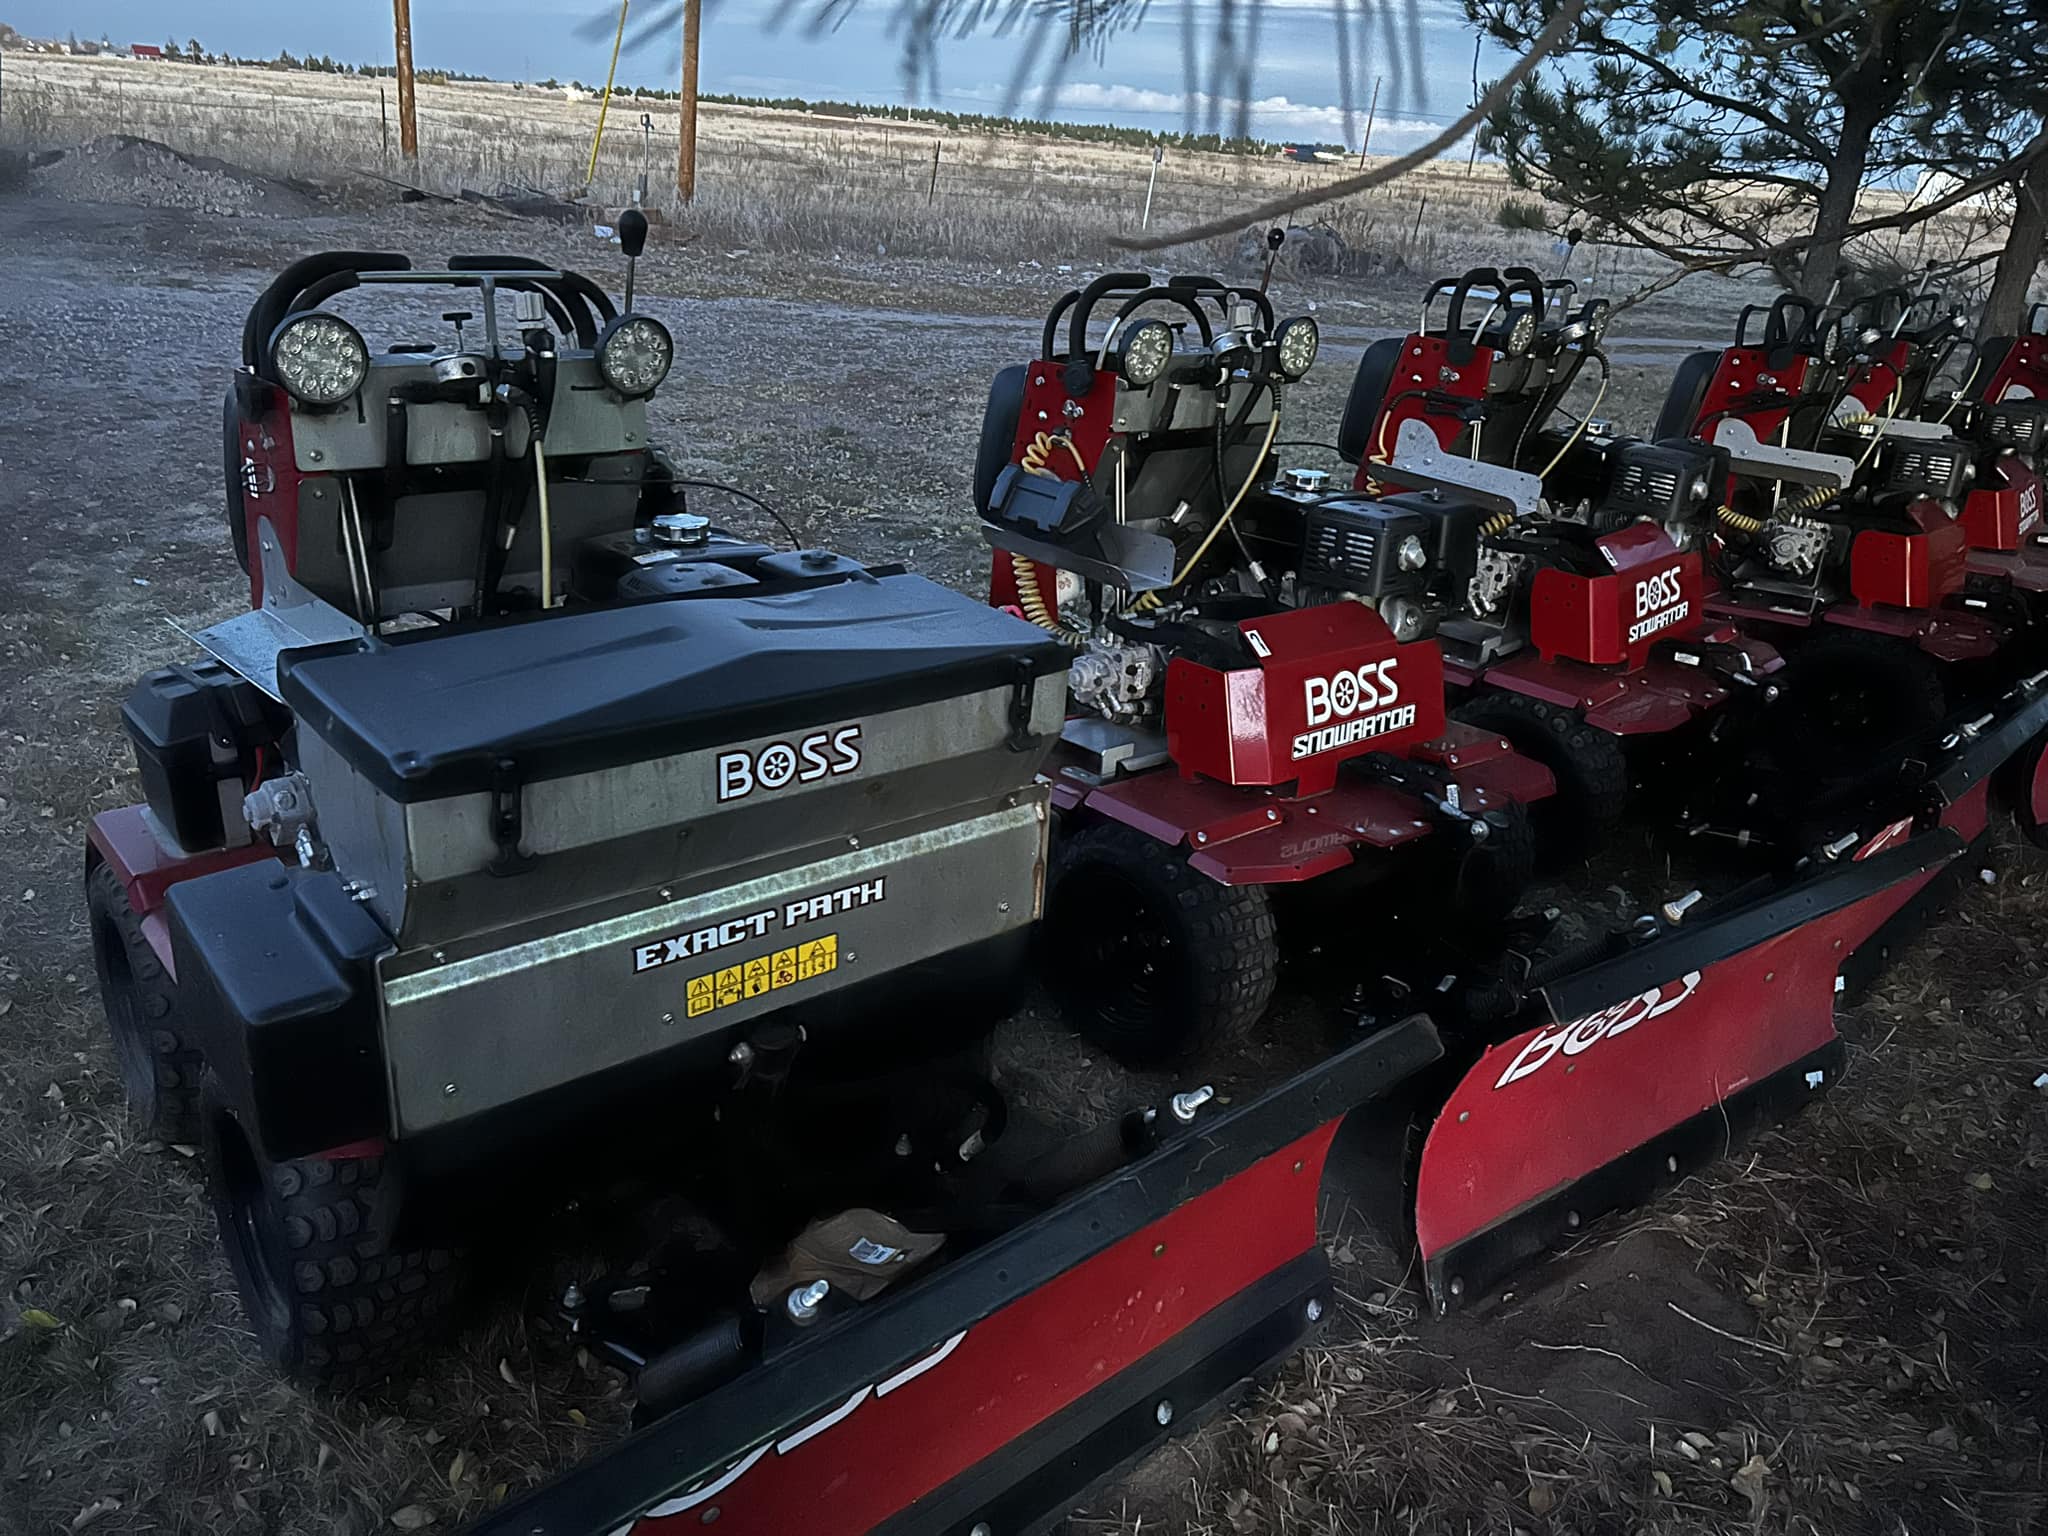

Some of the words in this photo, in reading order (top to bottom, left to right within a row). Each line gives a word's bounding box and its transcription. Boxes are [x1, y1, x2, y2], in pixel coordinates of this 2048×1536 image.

[1636, 566, 1681, 618] BOSS
[1304, 657, 1399, 727] BOSS
[718, 726, 862, 802] BOSS
[634, 910, 776, 973] EXACT
[783, 877, 886, 928] PATH
